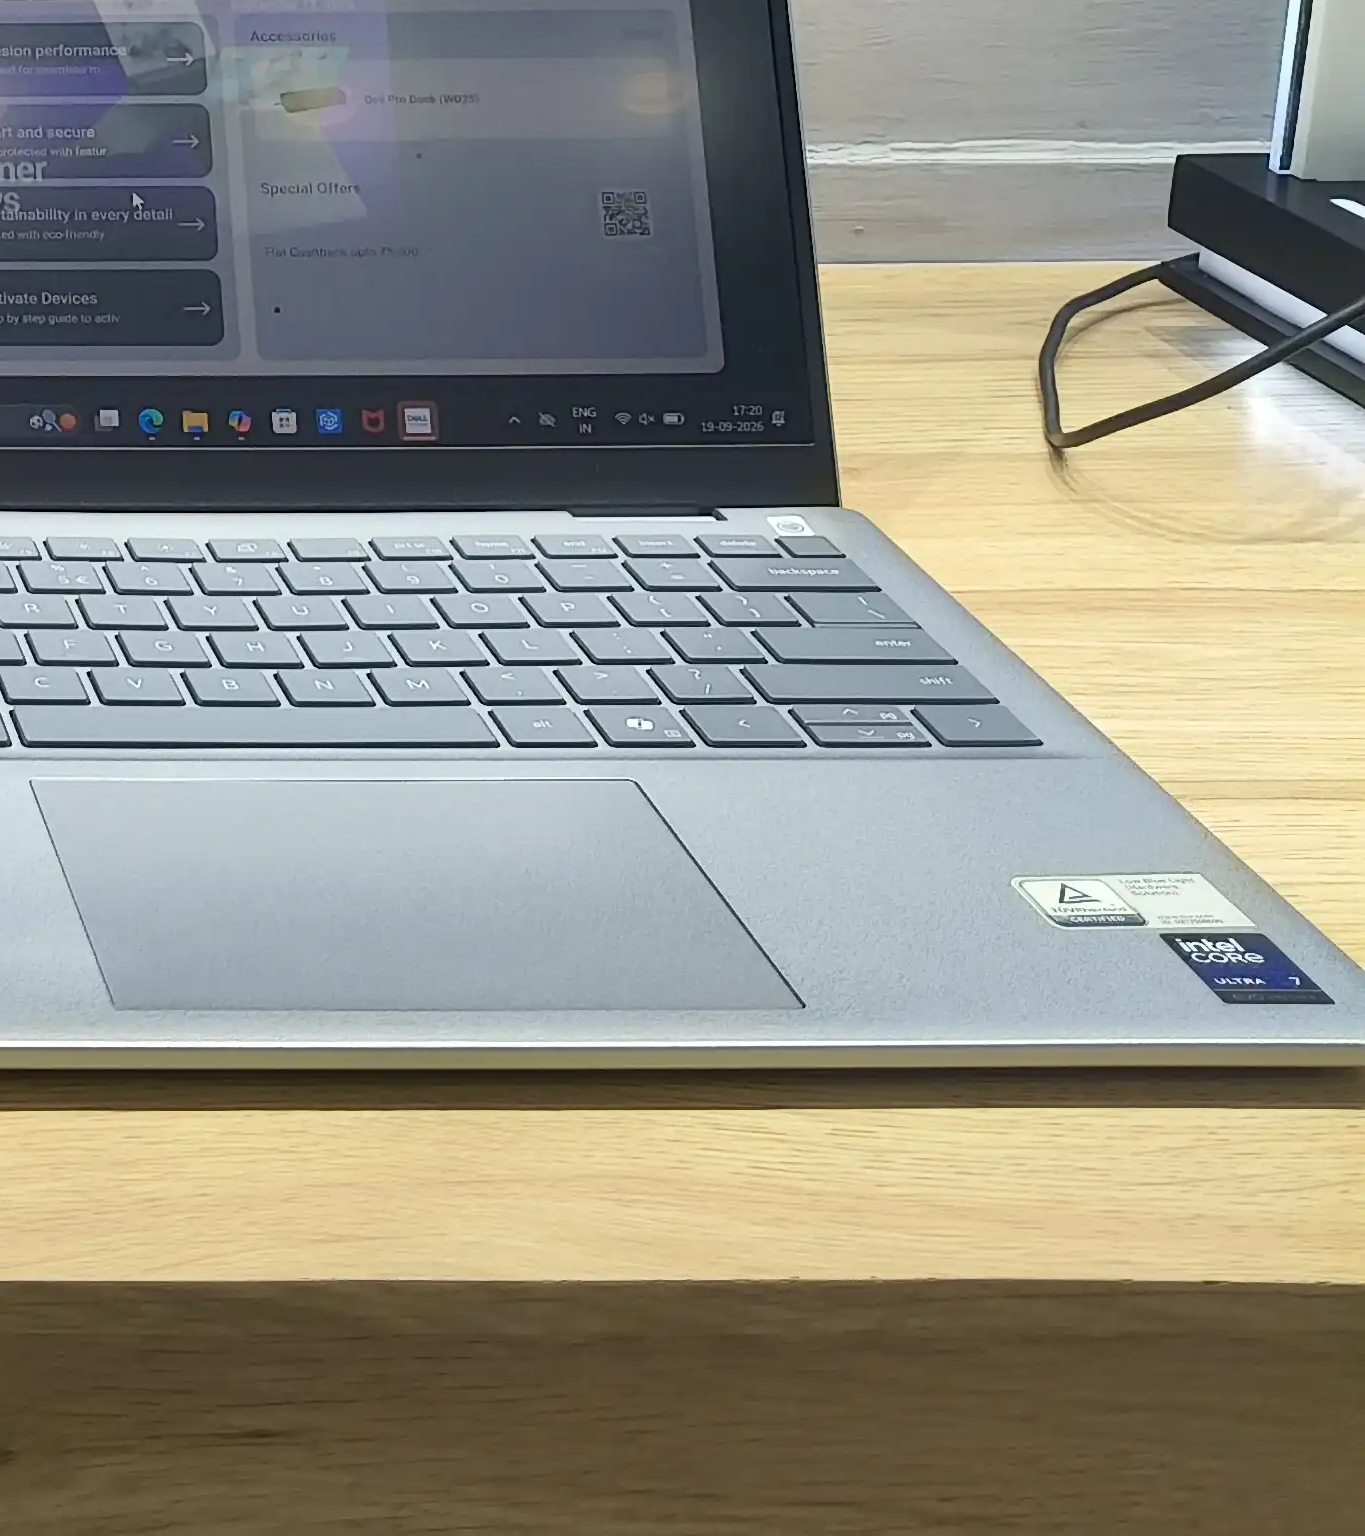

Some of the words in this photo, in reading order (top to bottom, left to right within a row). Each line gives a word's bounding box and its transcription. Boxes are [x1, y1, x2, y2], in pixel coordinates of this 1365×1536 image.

[36, 44, 127, 60] performance
[17, 125, 43, 139] and
[47, 126, 96, 140] secure
[261, 181, 313, 198] Special
[317, 181, 361, 195] Offers
[74, 208, 86, 221] in
[91, 209, 129, 225] every
[133, 207, 173, 222] detail
[41, 292, 98, 306] Devices
[6, 313, 19, 326] by
[22, 313, 45, 326] step
[81, 313, 91, 323] to
[572, 406, 597, 417] ENG
[733, 405, 763, 416] 17:20
[579, 423, 592, 434] IN
[701, 421, 765, 433] 19-09-2026
[768, 567, 839, 577] backspace
[875, 639, 911, 648] enter
[919, 675, 953, 686] shift
[533, 719, 552, 729] alt
[1175, 937, 1245, 953] intel
[1213, 977, 1268, 986] ULTRA
[1288, 977, 1301, 986] 7
